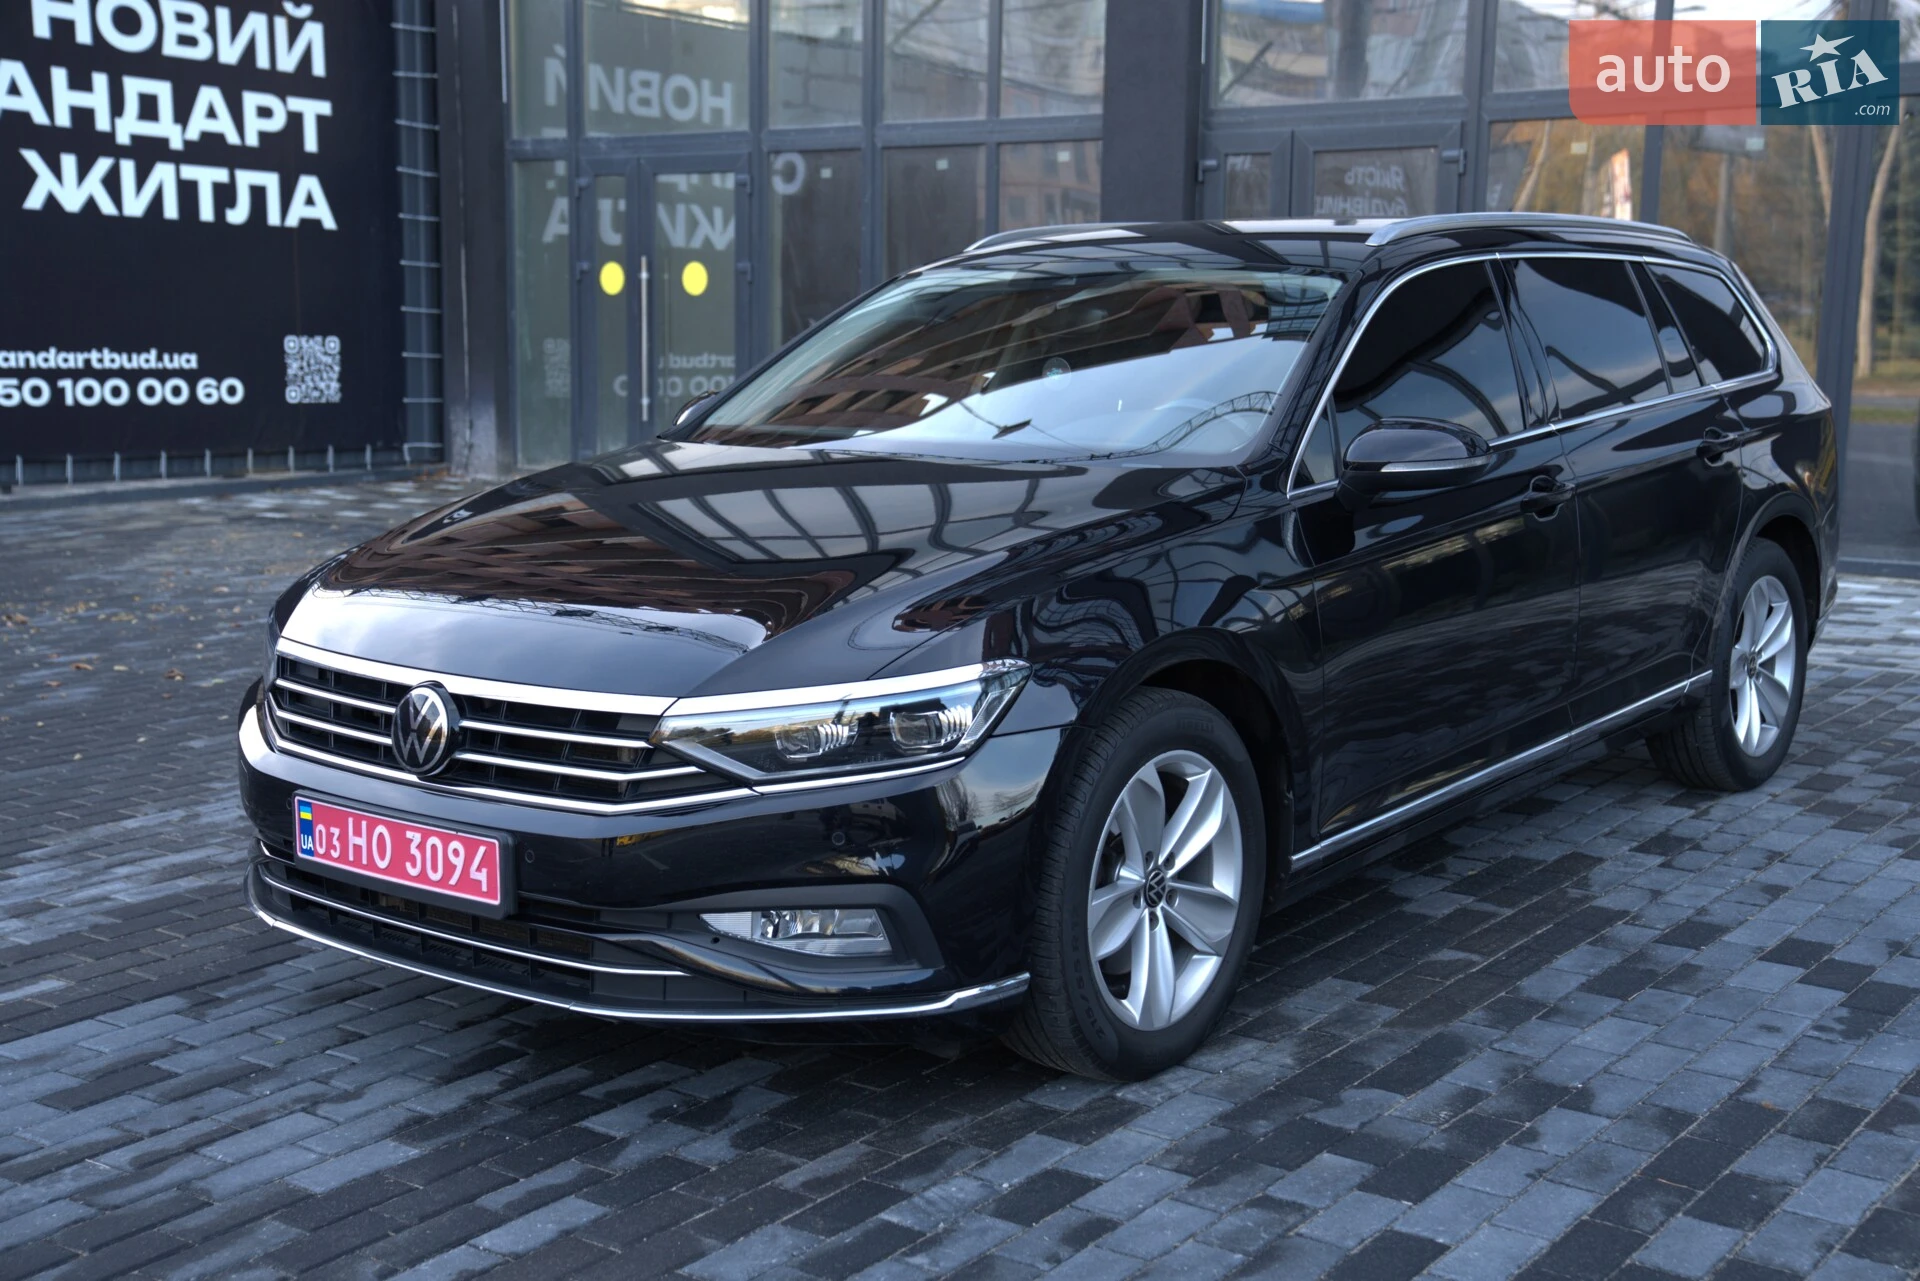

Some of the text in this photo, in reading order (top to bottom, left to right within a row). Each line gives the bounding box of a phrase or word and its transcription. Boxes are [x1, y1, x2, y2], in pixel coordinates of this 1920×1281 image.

[30, 0, 327, 78] НОВИЙ
[0, 58, 333, 154] АНДАРТ
[18, 147, 338, 231] ЖИТЛА
[0, 346, 199, 370] andartbud.ua
[0, 376, 245, 407] 50 100 00 60
[300, 816, 488, 893] UA 03 HO 3094
